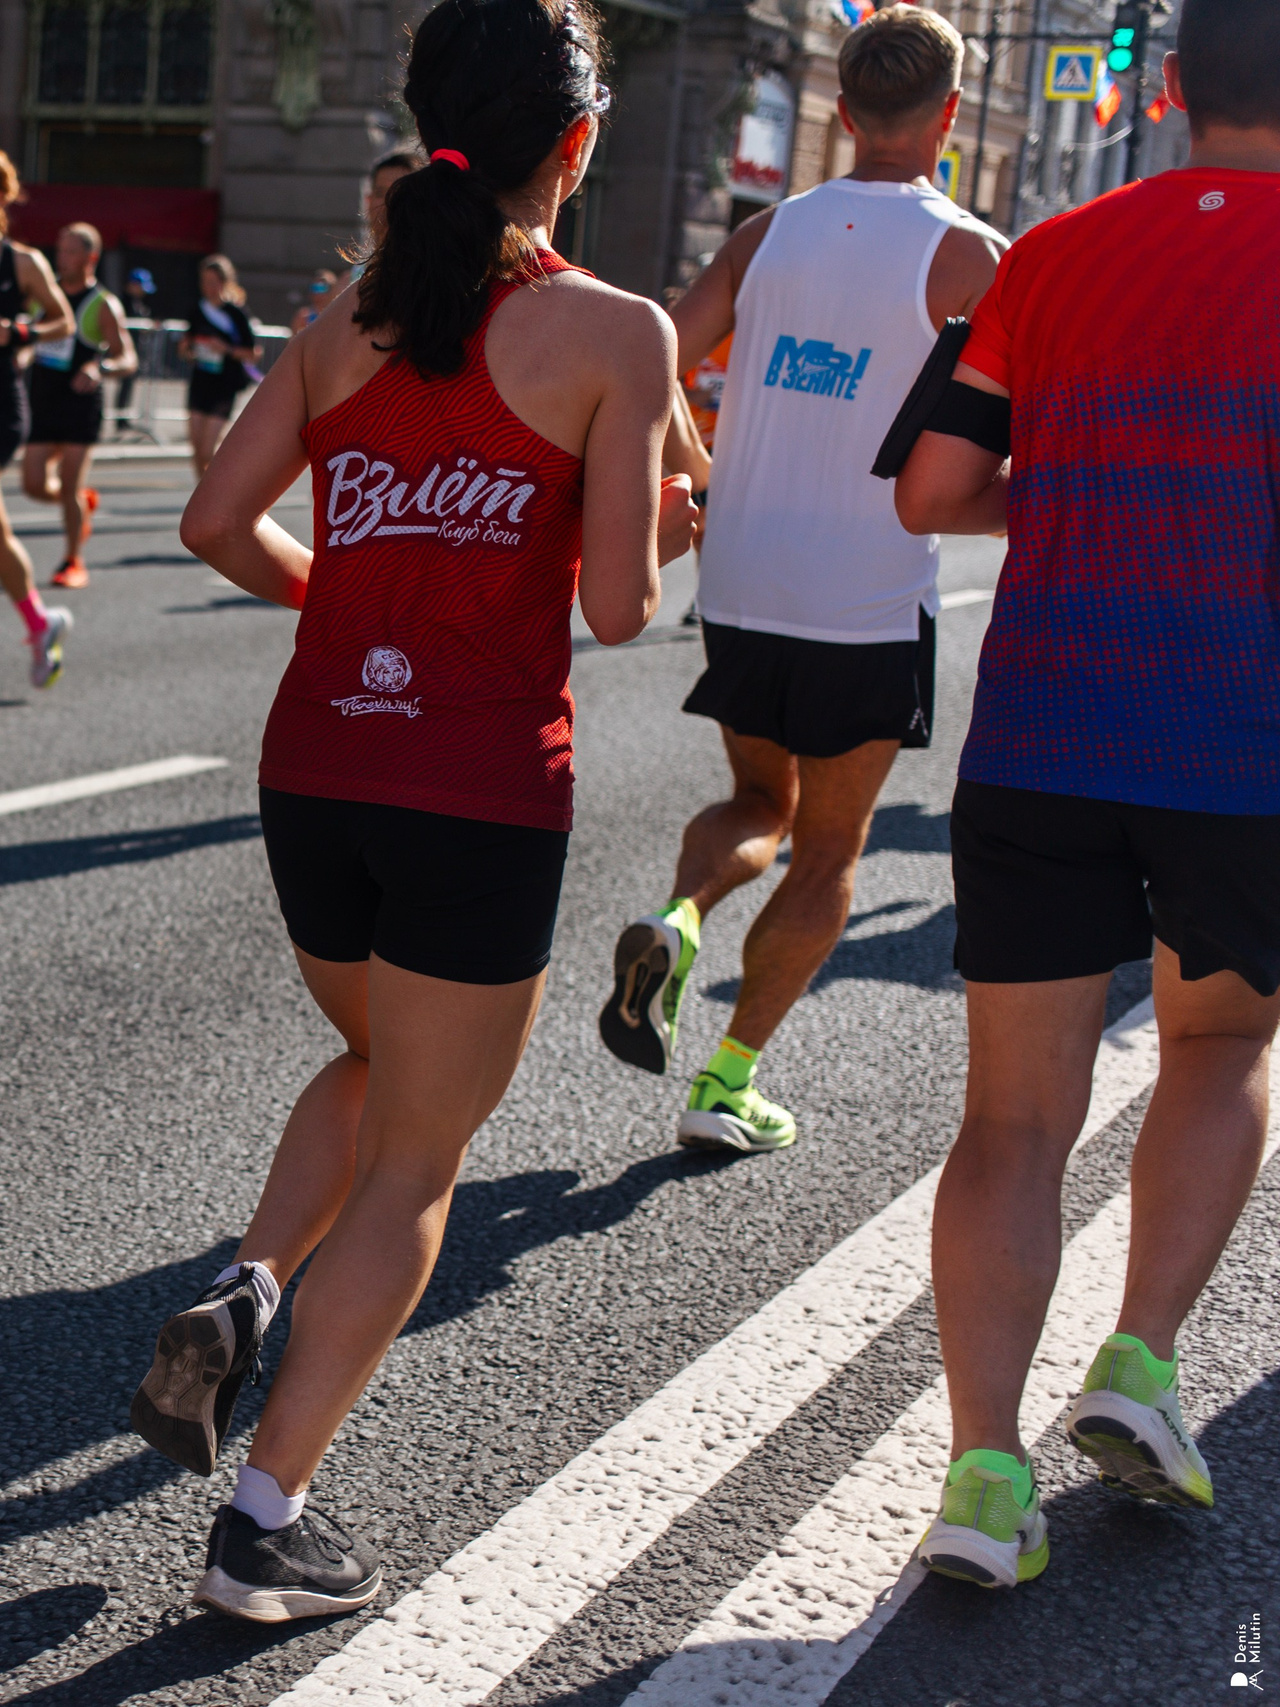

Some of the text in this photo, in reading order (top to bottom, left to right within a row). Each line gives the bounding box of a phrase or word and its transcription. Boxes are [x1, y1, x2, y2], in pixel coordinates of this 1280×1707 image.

[781, 362, 858, 400] ЗЕНИТЕ
[326, 450, 536, 546] Взлёт
[437, 518, 521, 547] Клуб бега
